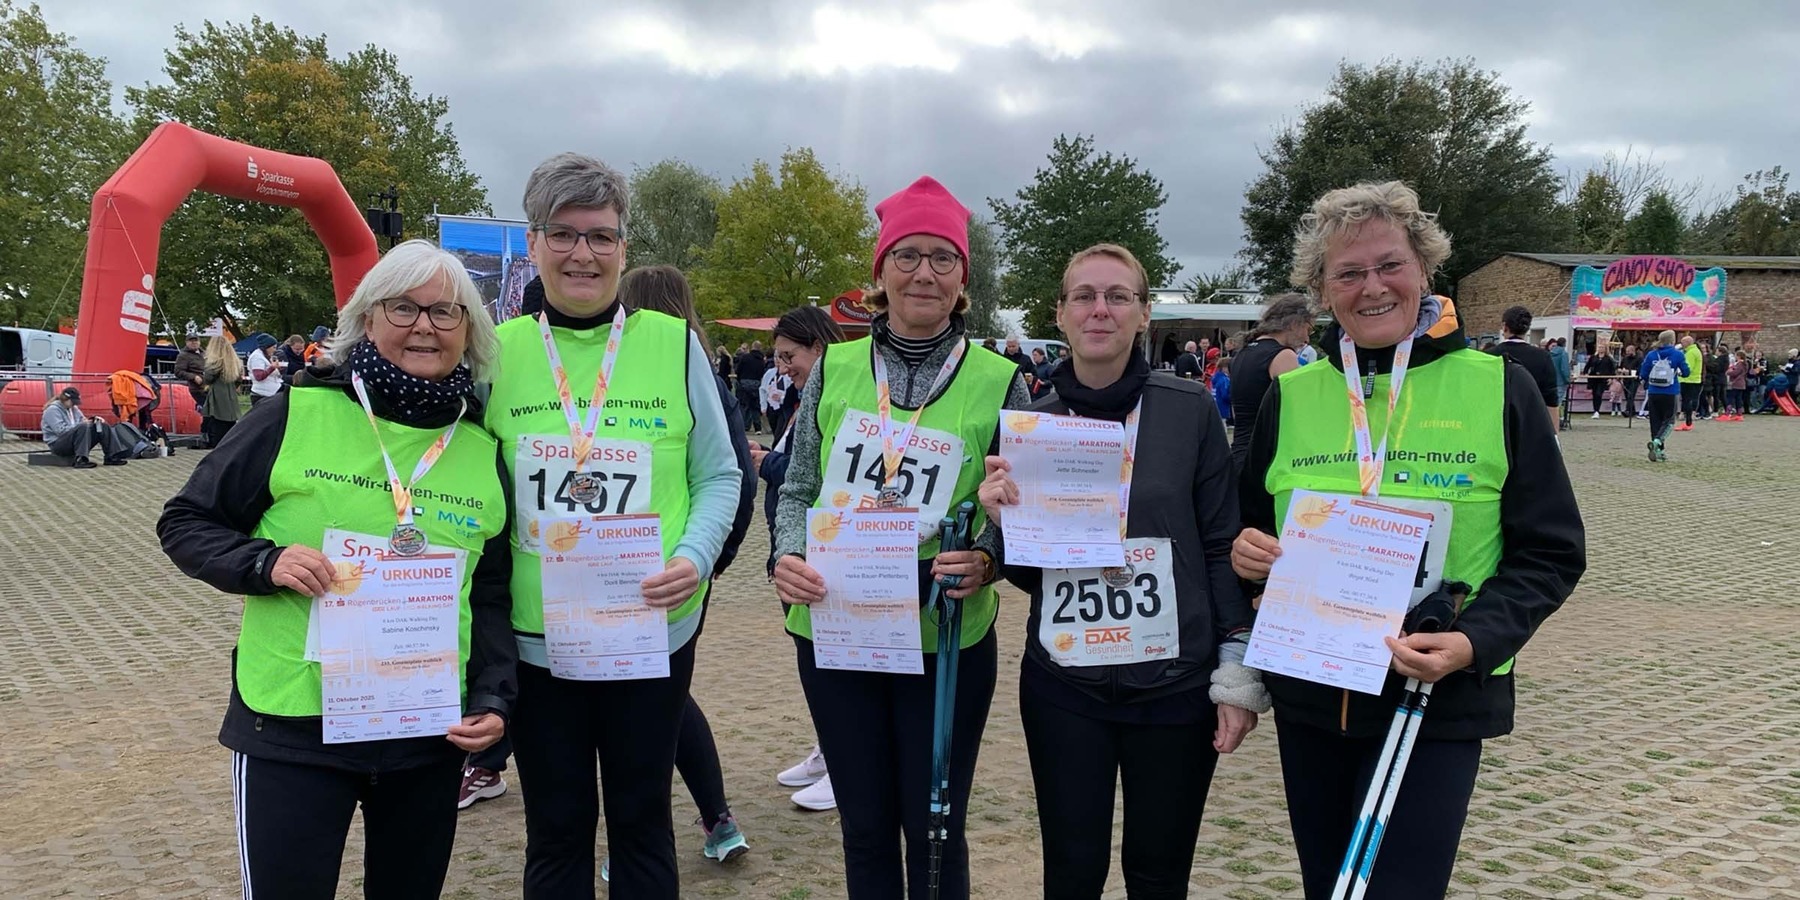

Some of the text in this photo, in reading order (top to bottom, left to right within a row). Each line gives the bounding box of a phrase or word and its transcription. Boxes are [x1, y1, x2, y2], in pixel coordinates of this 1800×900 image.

[261, 169, 294, 186] Sparkasse
[1604, 258, 1695, 292] CANDY SHOP
[629, 418, 653, 429] MV
[1056, 420, 1120, 430] URKUNDE
[856, 418, 950, 456] Sprasse
[532, 440, 636, 462] Spaasse
[845, 443, 941, 505] 1451
[1423, 472, 1454, 488] MV
[438, 510, 466, 526] MV
[856, 520, 915, 532] URKUNDE
[1350, 513, 1424, 538] URKUNDE
[597, 526, 658, 539] URKUNDE
[1368, 546, 1416, 561] MARATHON
[382, 567, 452, 581] URKUNDE
[408, 594, 454, 603] MARATHON
[1052, 572, 1162, 624] 2563
[1085, 627, 1132, 644] DAK
[1085, 644, 1134, 654] Gesundheit
